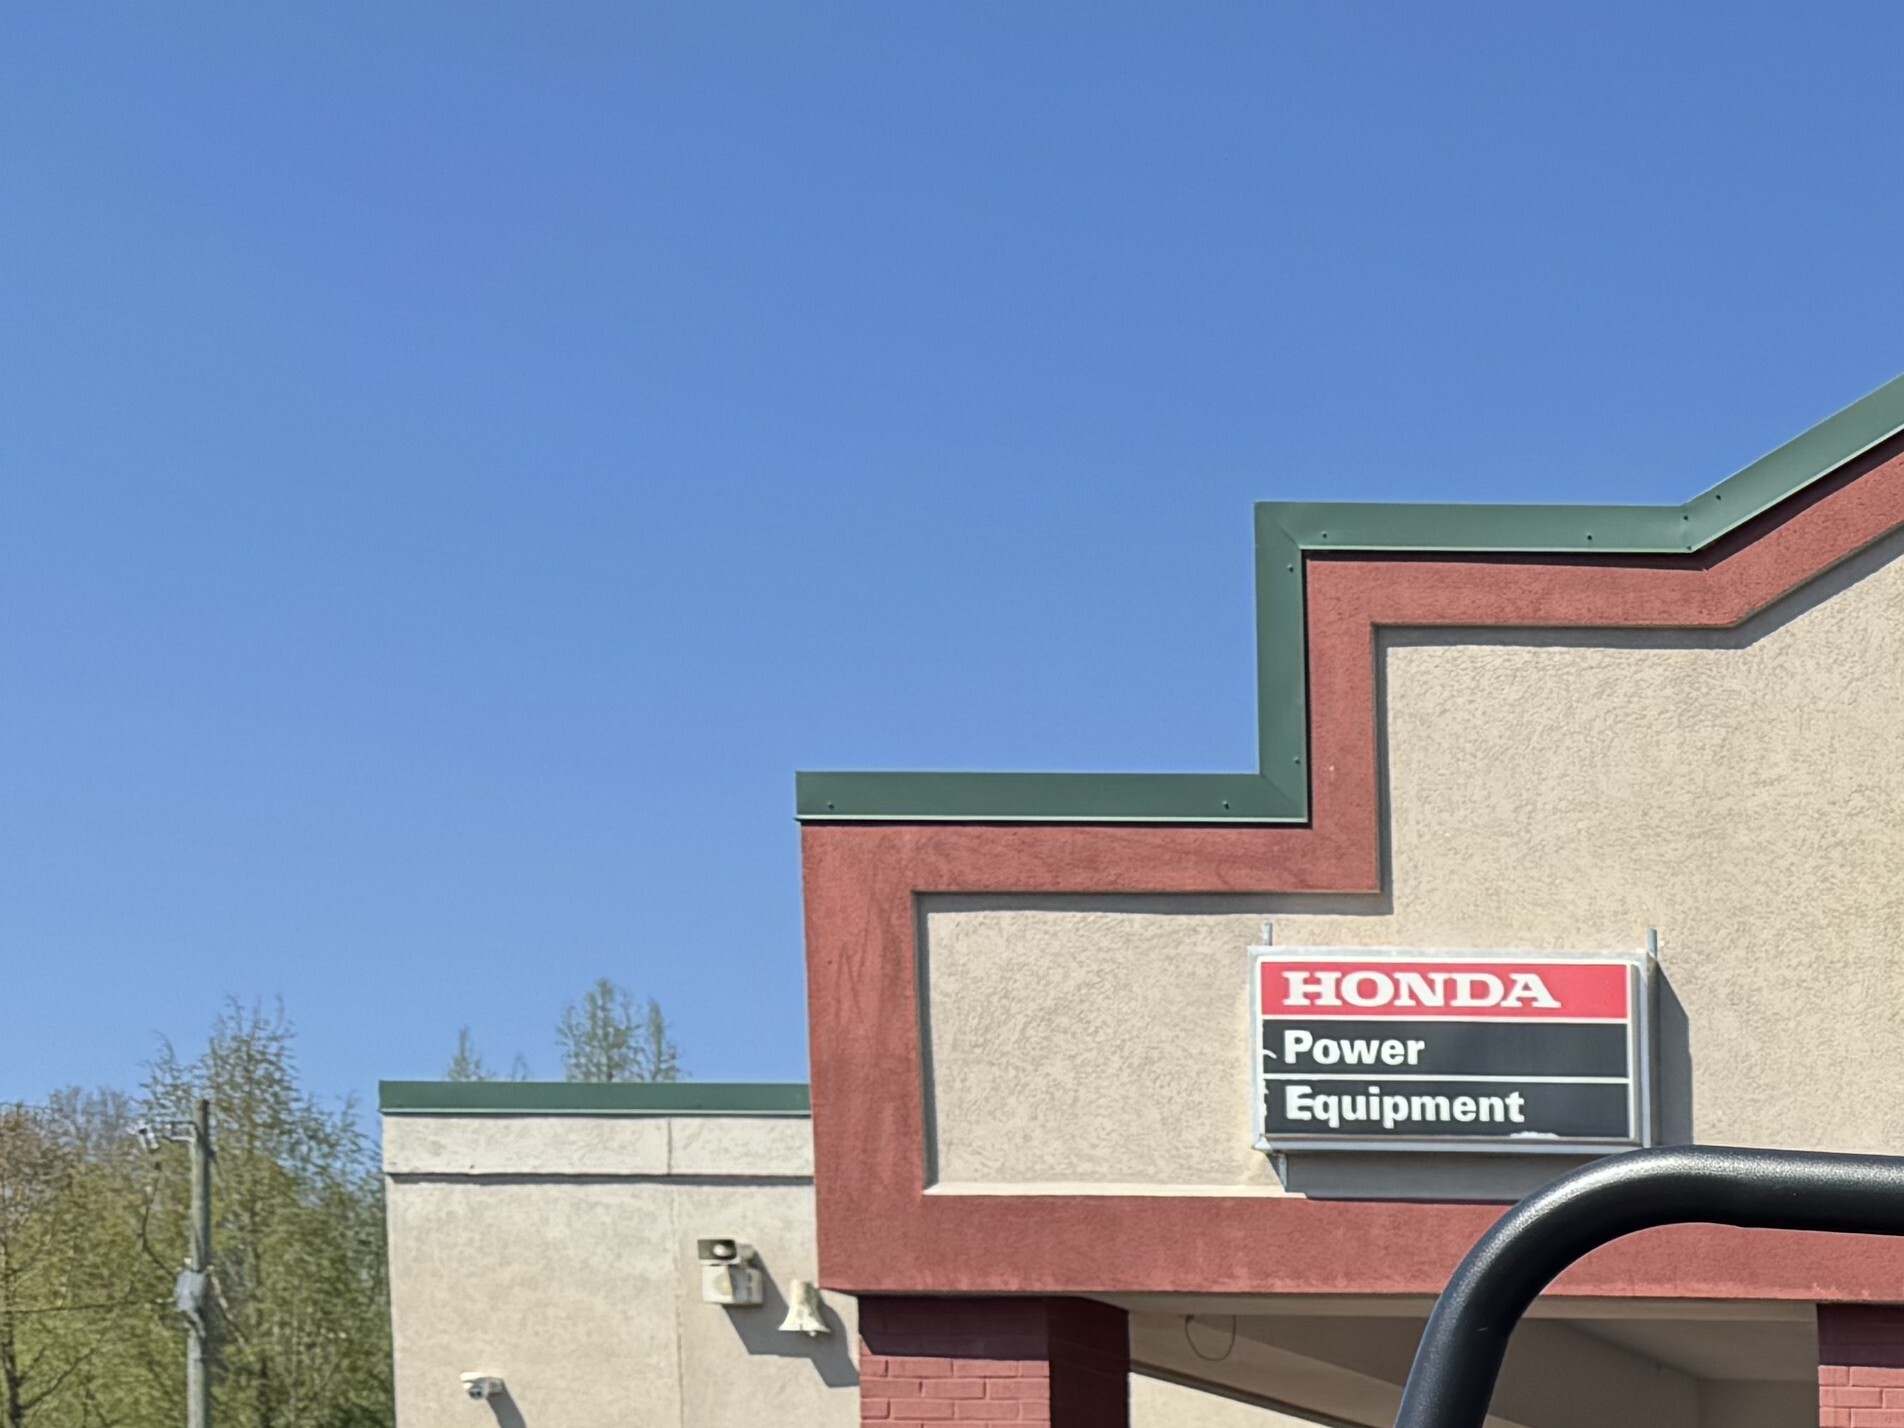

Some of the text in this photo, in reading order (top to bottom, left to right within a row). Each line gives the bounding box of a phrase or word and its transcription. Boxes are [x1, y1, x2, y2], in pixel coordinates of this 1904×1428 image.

[1282, 971, 1562, 1009] HONDA
[1283, 1030, 1426, 1066] Power
[1285, 1085, 1525, 1129] Equipment
